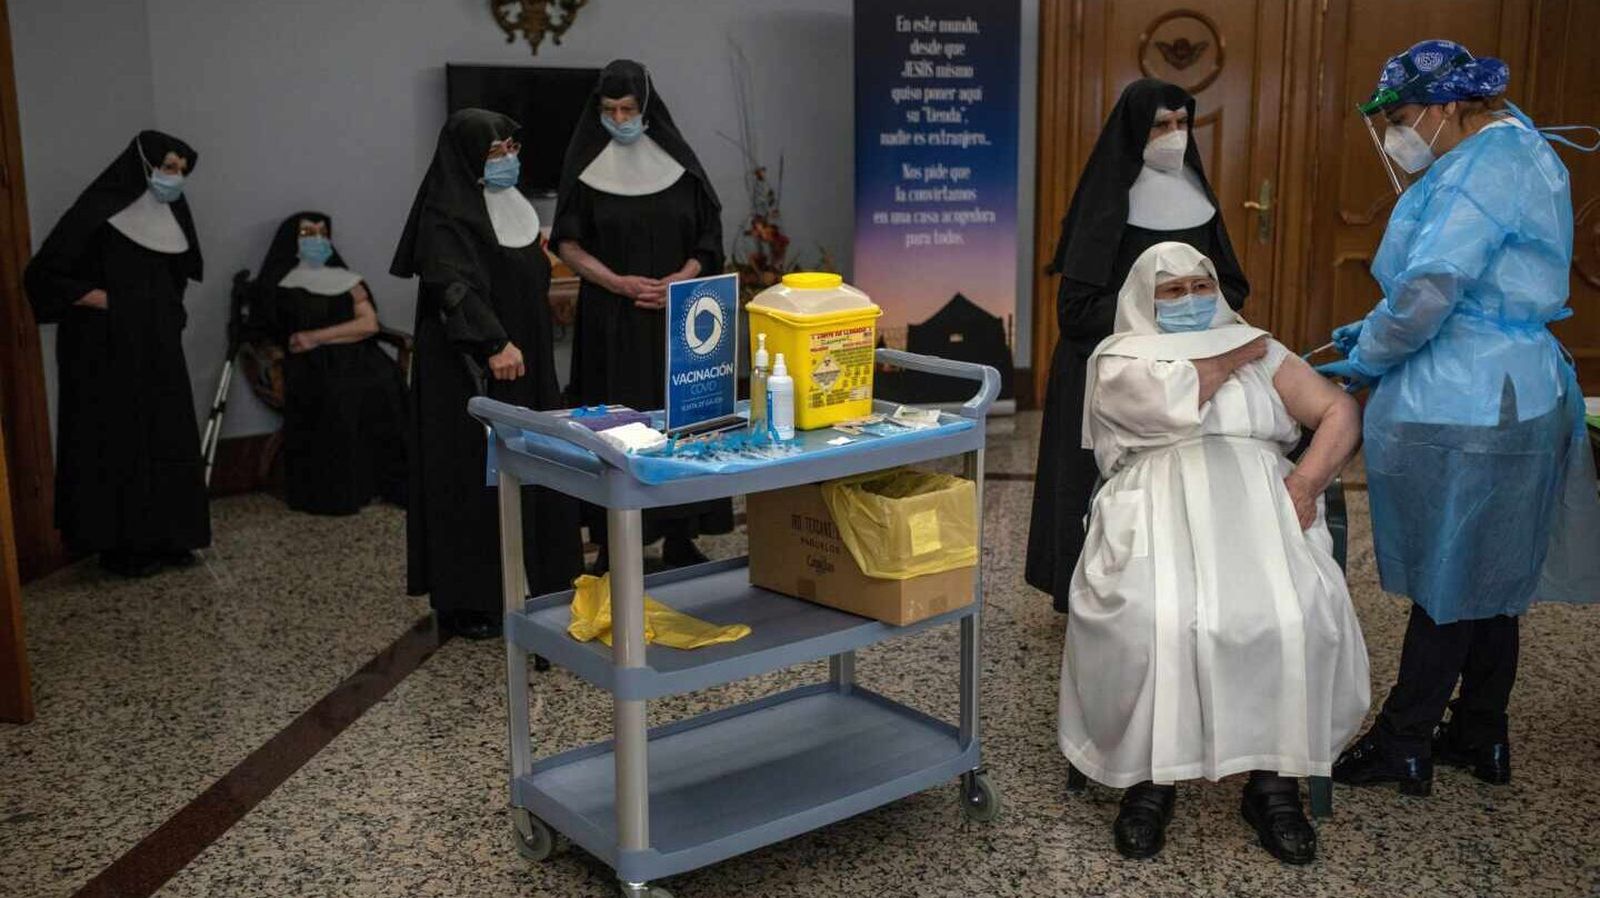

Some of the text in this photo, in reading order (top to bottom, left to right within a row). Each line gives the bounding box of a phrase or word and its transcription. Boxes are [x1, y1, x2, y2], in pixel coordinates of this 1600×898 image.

[896, 15, 911, 32] En
[913, 16, 937, 32] este
[910, 40, 966, 59] desde que
[936, 63, 974, 78] mismo
[891, 87, 922, 104] quiso
[924, 88, 957, 104] poner
[906, 110, 920, 122] su
[880, 129, 911, 145] nadie
[913, 133, 926, 145] es
[902, 163, 971, 183] Nos pide que
[908, 186, 977, 202] convirtamos
[873, 207, 996, 226] en una casa acogedora
[905, 233, 931, 248] para
[672, 361, 734, 386] VACINACIÓN
